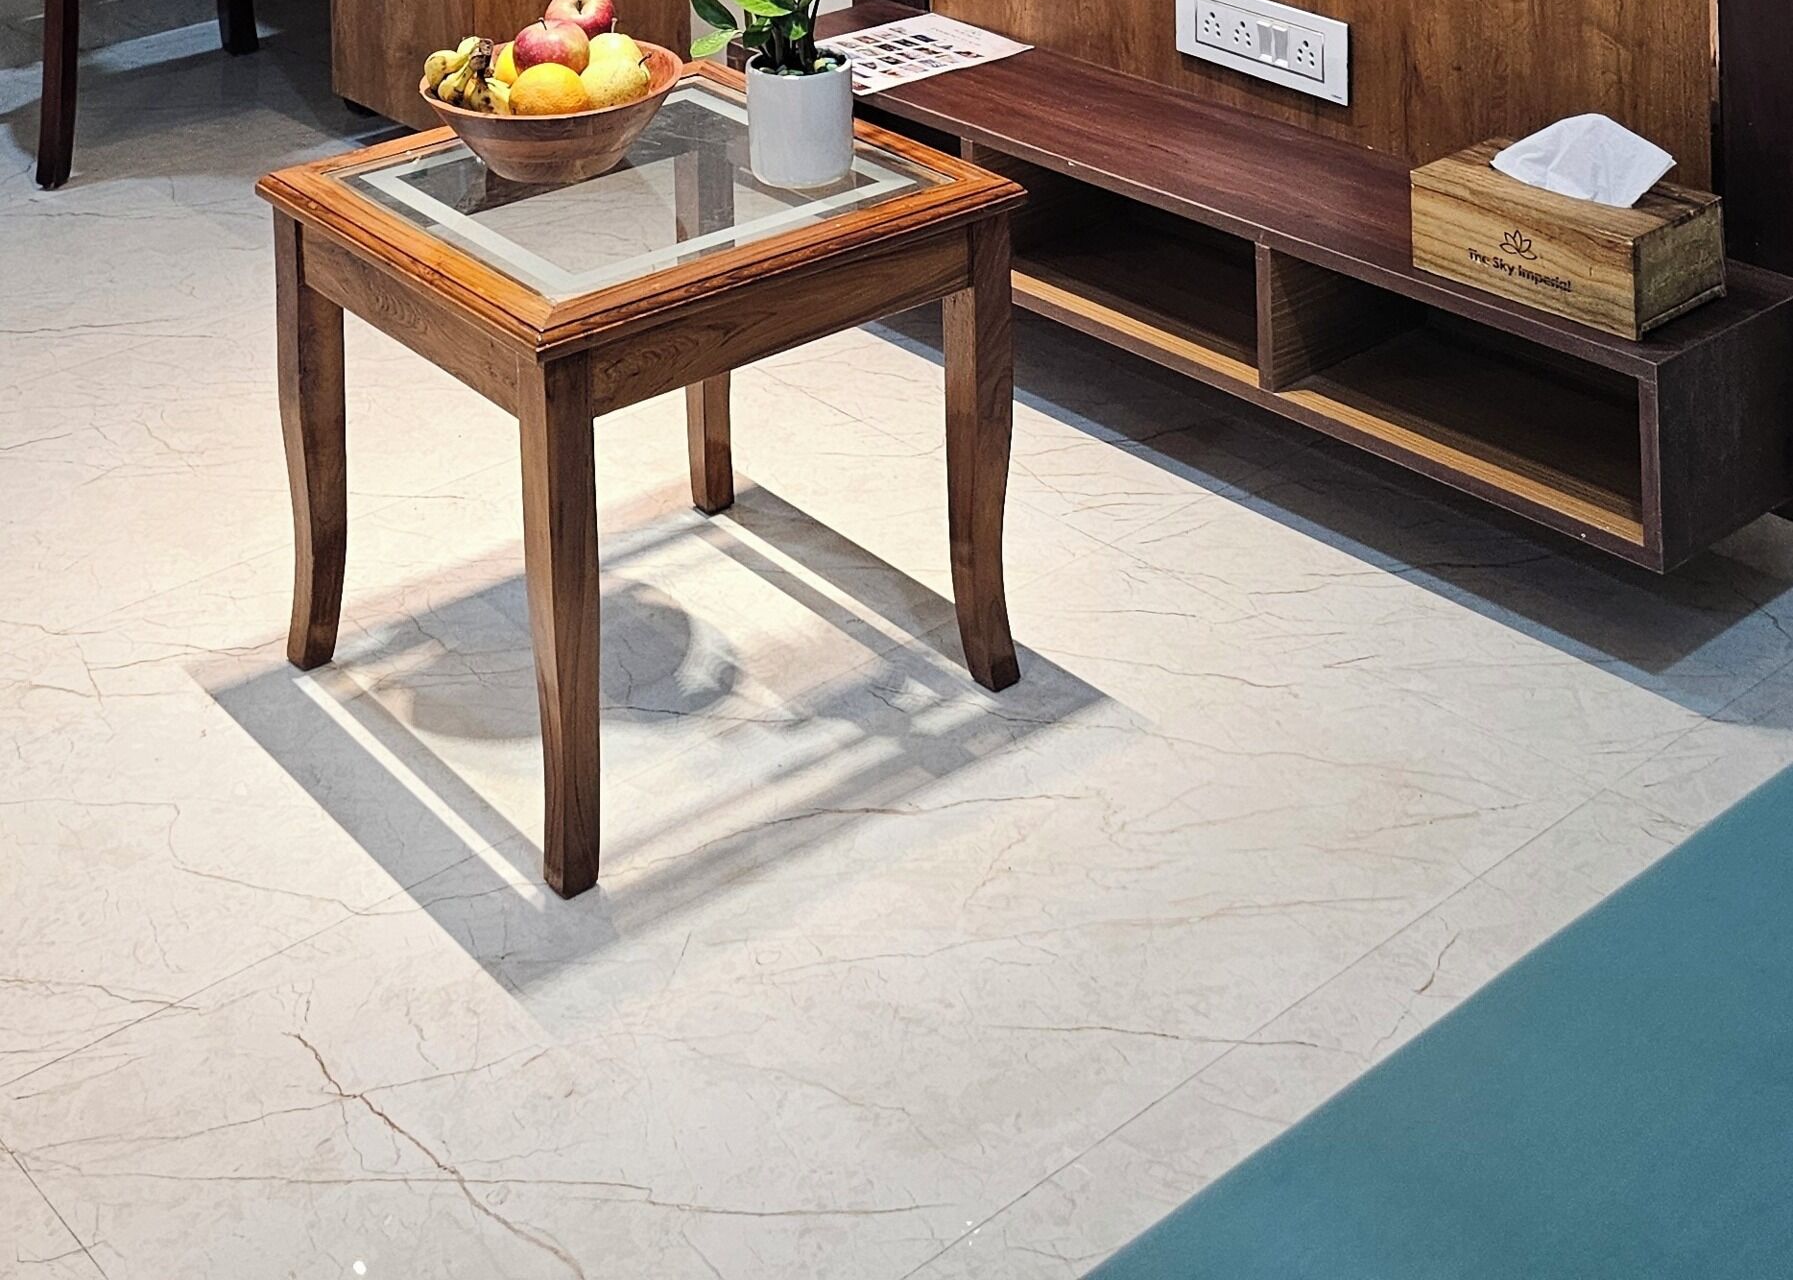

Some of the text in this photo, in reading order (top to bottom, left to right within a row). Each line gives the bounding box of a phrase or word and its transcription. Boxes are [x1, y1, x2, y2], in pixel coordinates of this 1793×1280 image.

[1468, 248, 1572, 293] The Sky Imperial
